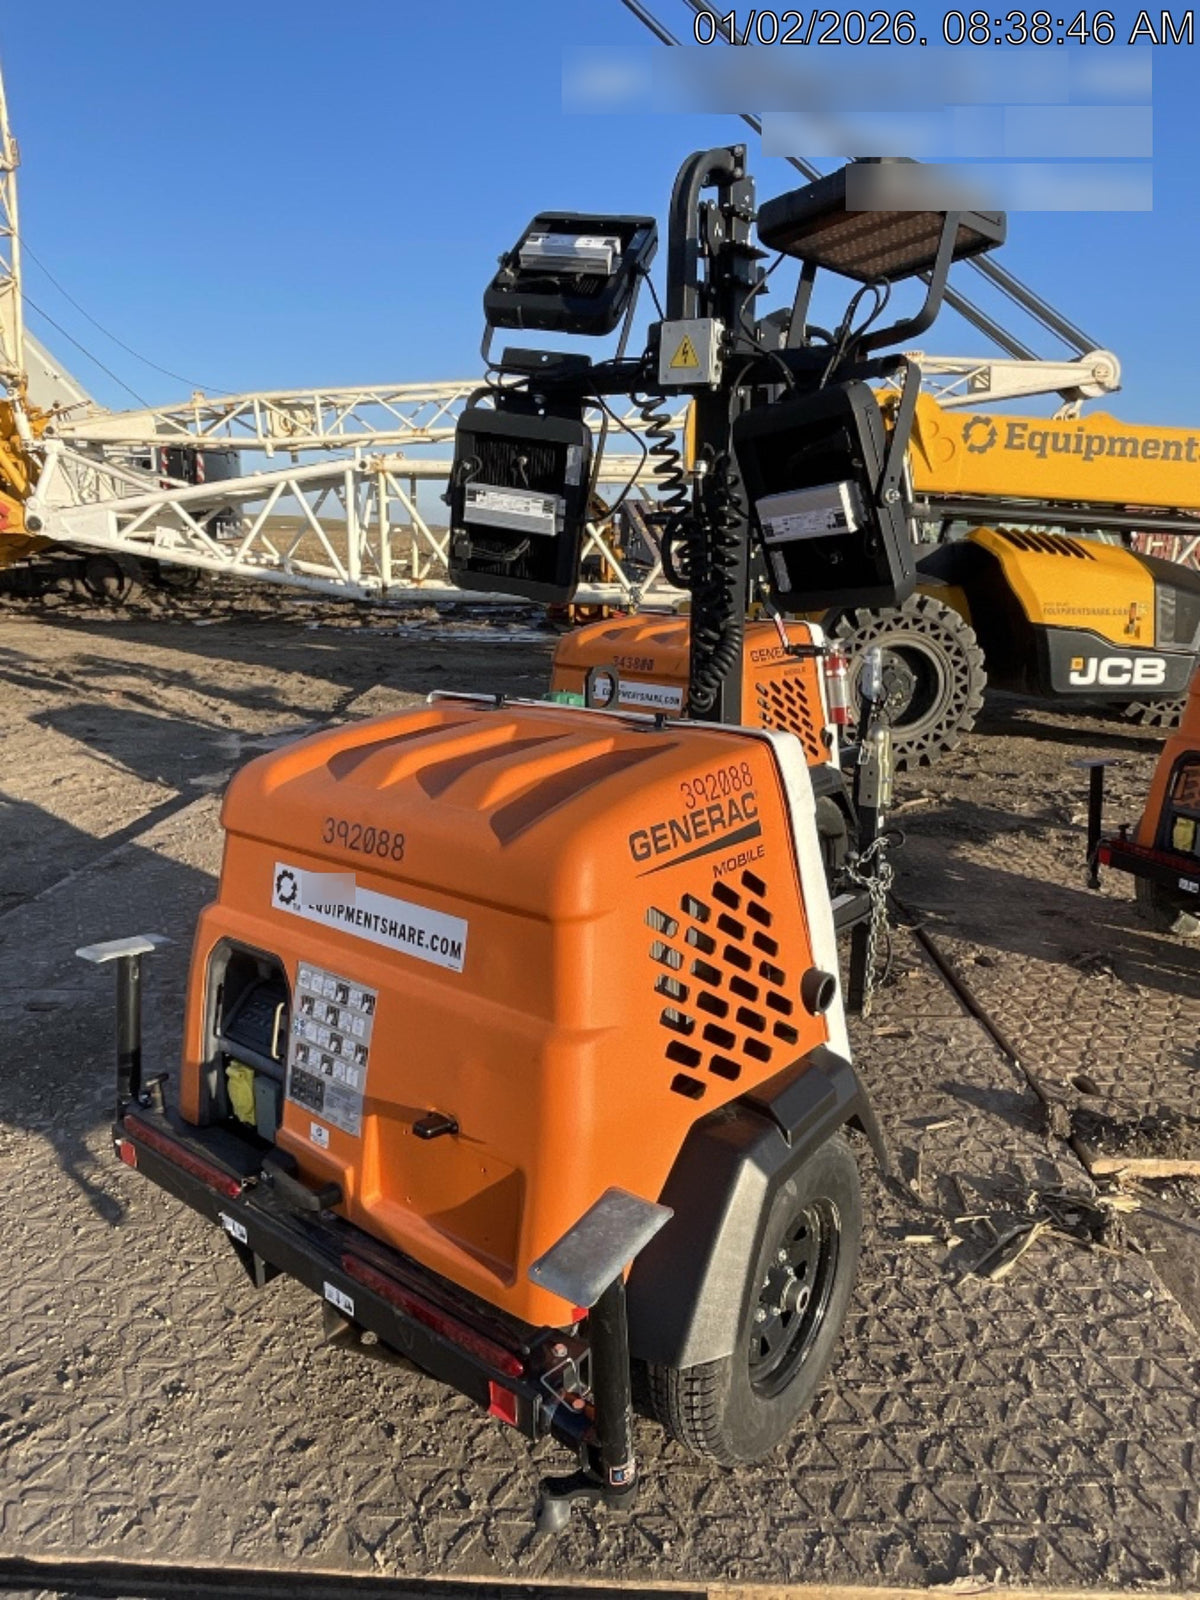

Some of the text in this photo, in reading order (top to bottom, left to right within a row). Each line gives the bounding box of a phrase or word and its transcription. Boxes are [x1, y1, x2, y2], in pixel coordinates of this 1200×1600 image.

[1004, 422, 1200, 462] Equipment
[1069, 656, 1166, 686] JCB
[680, 762, 753, 810] 392088
[323, 817, 404, 862] 392088
[628, 791, 758, 862] GENERAC
[712, 845, 765, 879] MOBILE
